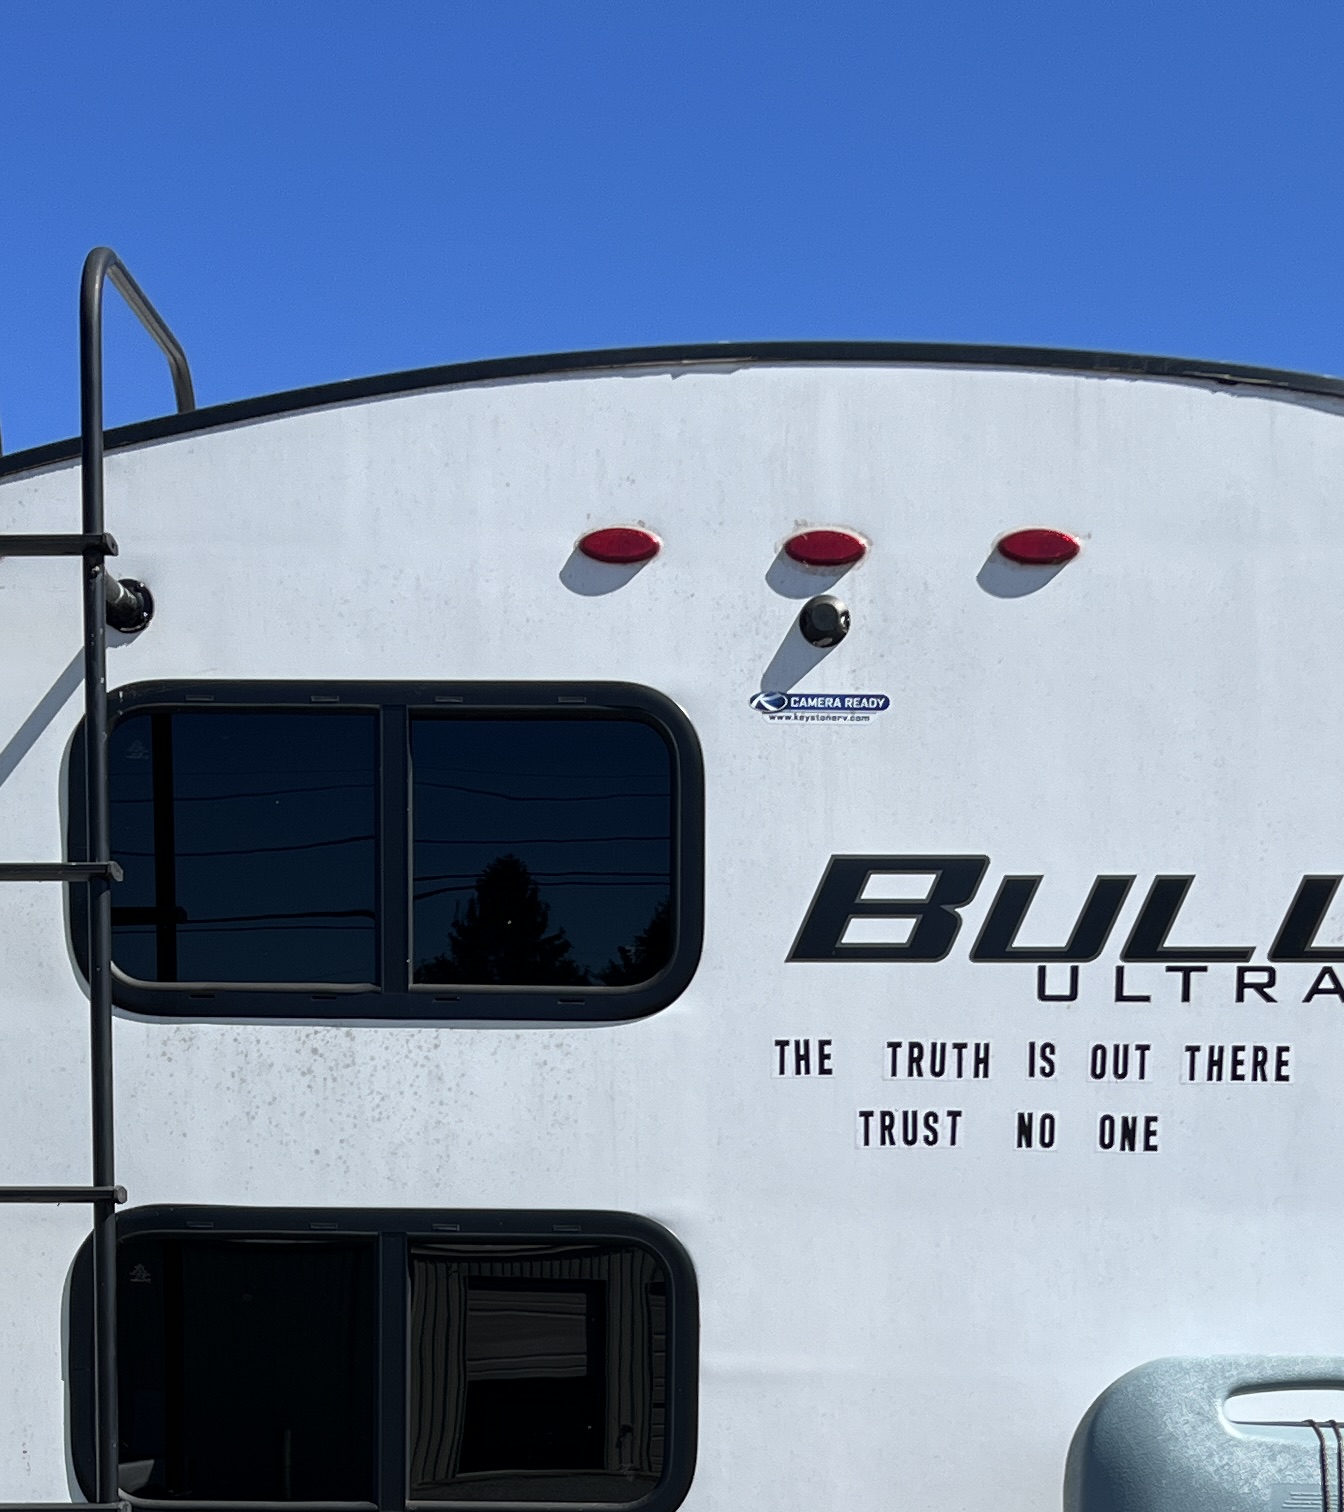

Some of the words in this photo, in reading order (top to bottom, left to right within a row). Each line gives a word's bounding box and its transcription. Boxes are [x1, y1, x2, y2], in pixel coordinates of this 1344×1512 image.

[790, 697, 842, 708] CAMERA
[844, 697, 885, 709] READY
[774, 1039, 834, 1076] THE
[886, 1041, 991, 1079] TRUTH
[1027, 1042, 1056, 1079] IS
[1090, 1043, 1152, 1080] OUT
[1184, 1045, 1292, 1082] THERE
[858, 1110, 963, 1147] TRUST
[1016, 1113, 1057, 1149] NO
[1099, 1115, 1159, 1152] ONE
